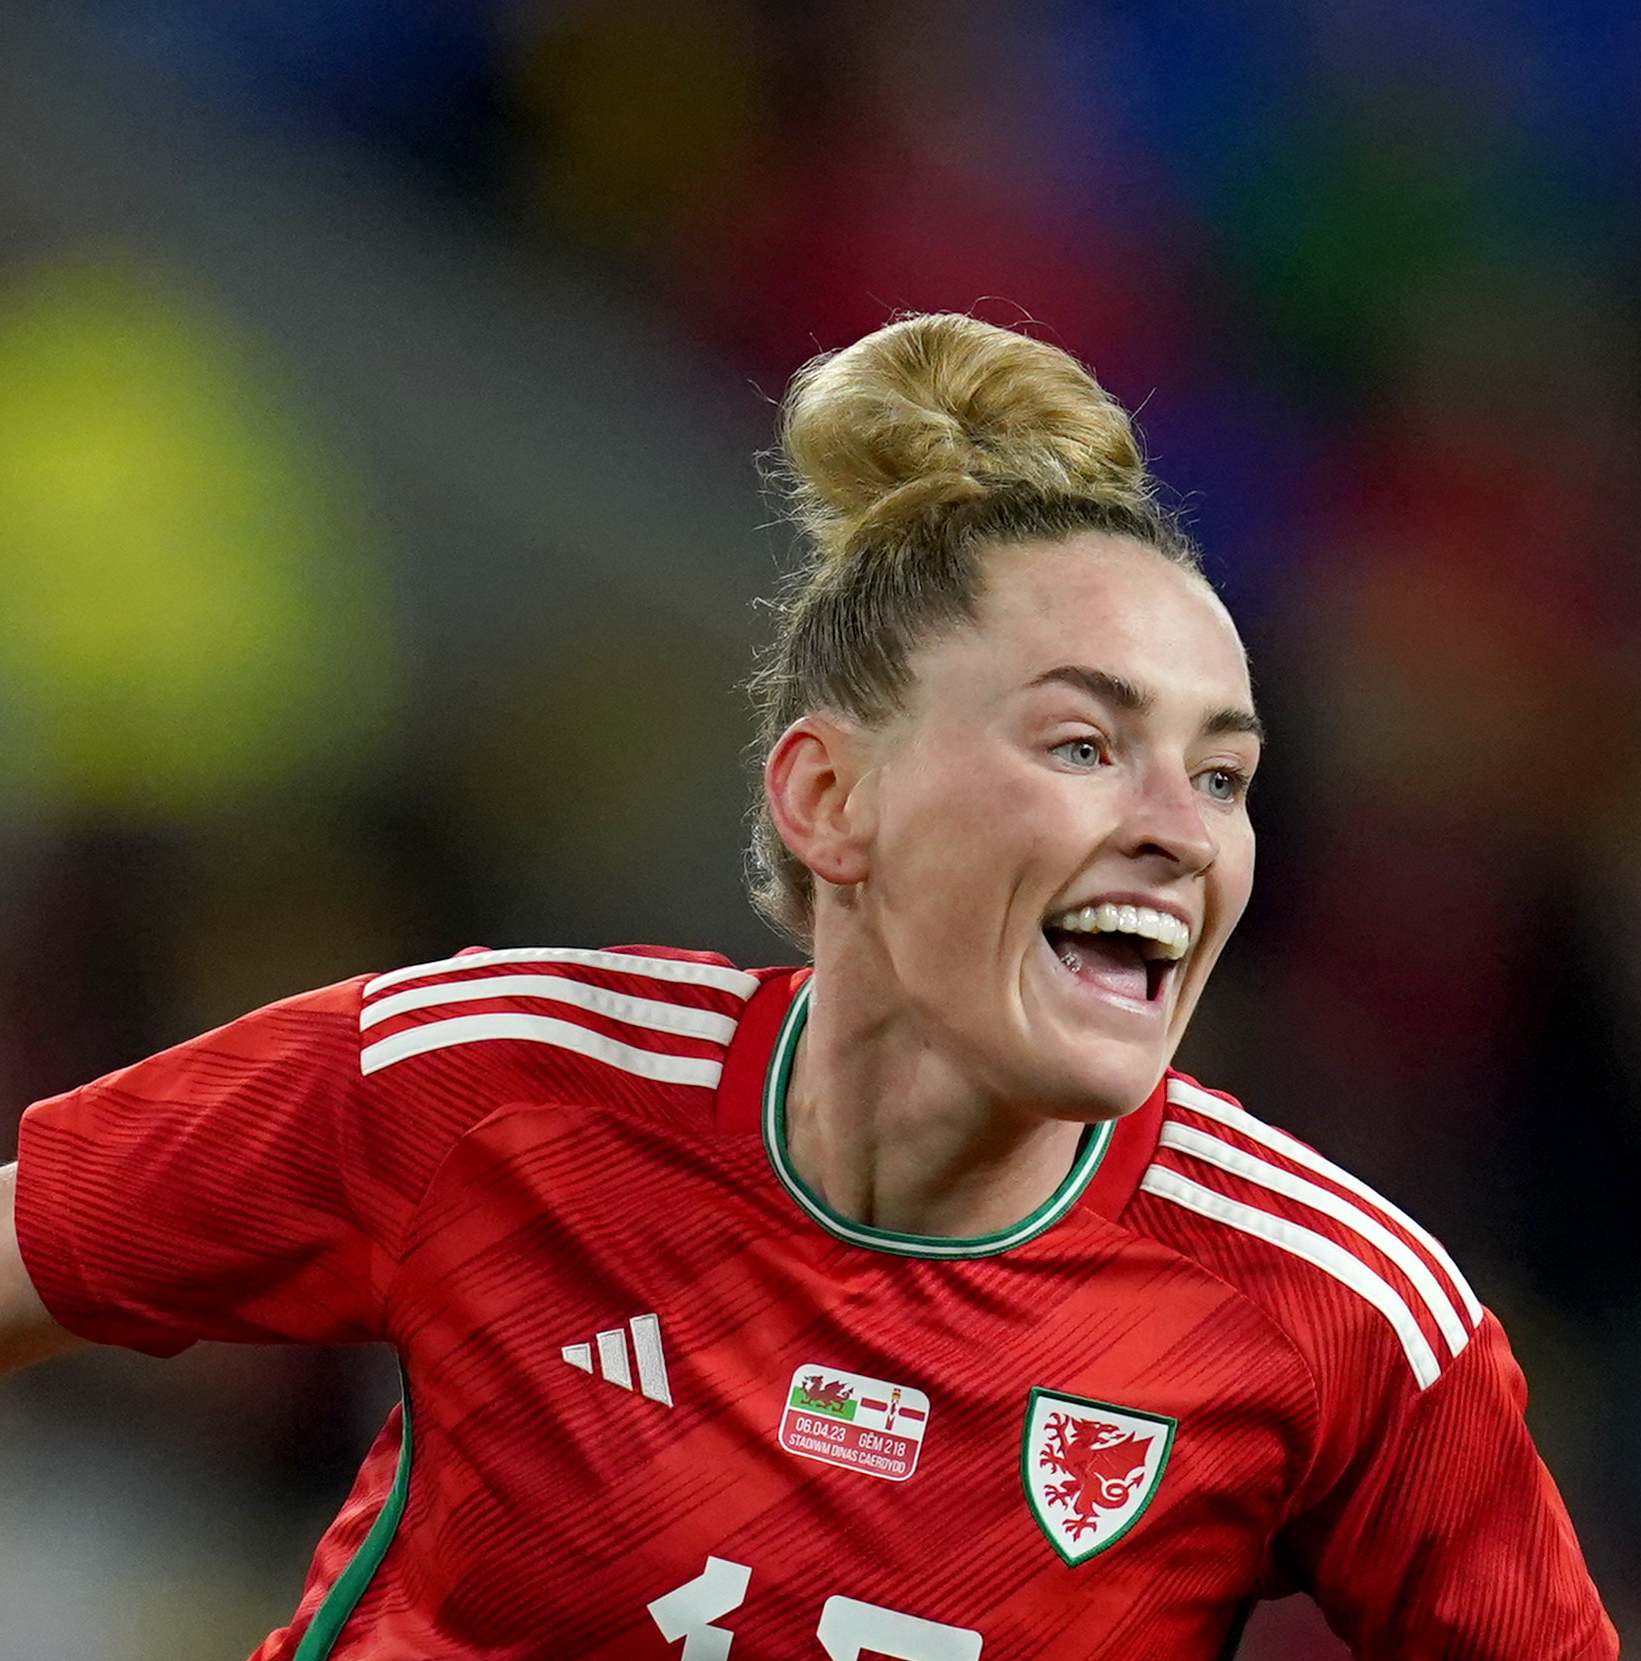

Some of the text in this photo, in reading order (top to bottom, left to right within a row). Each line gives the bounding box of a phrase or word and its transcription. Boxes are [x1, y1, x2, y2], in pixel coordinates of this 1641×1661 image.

[795, 1416, 906, 1457] 06.04.23 GÊM 218
